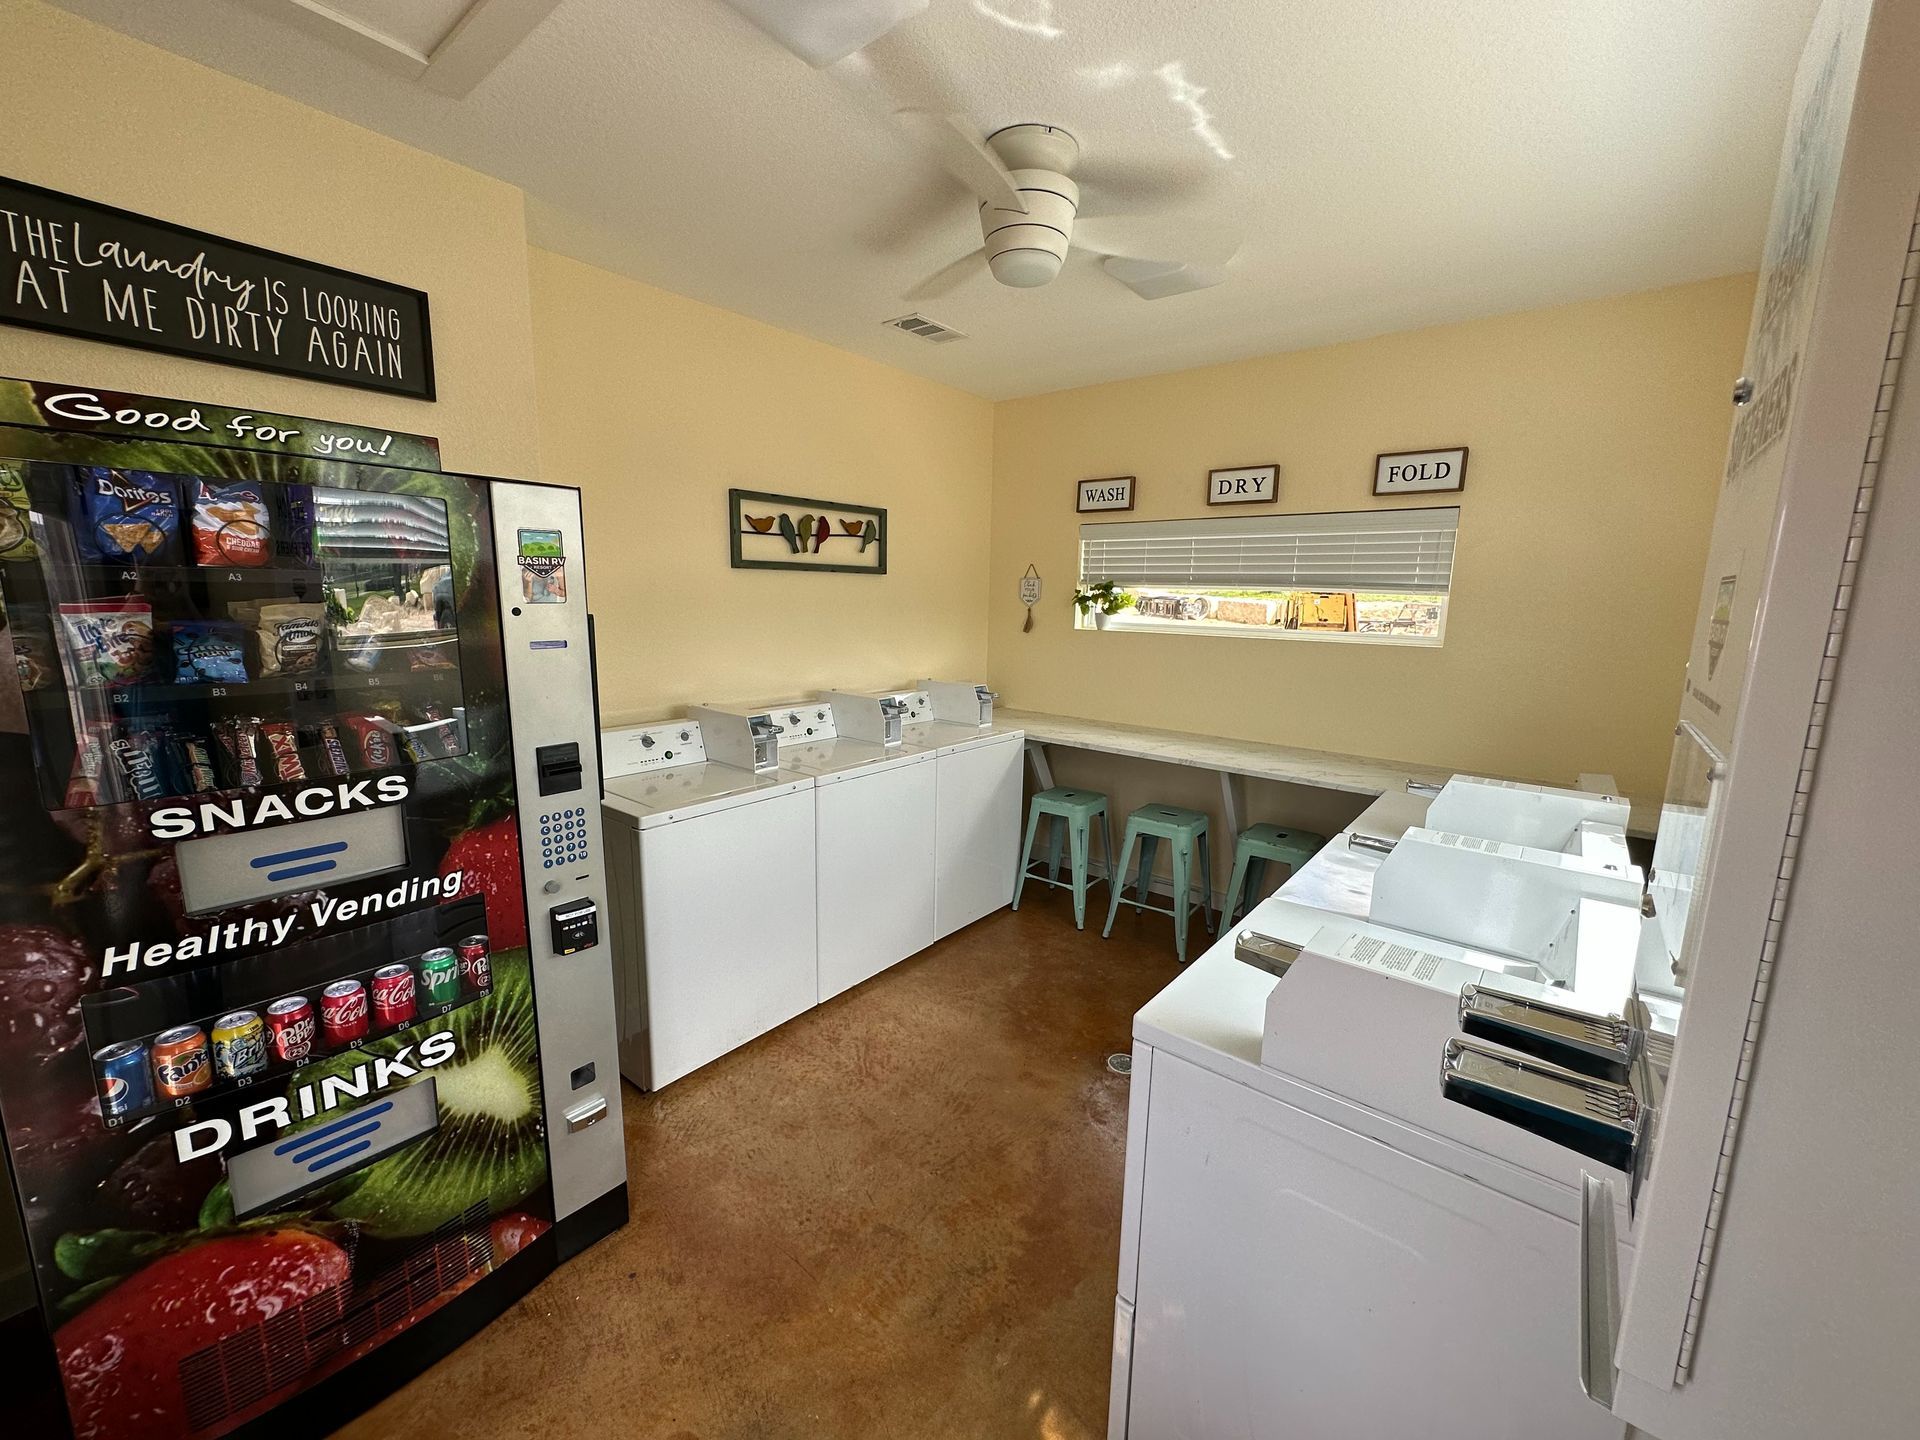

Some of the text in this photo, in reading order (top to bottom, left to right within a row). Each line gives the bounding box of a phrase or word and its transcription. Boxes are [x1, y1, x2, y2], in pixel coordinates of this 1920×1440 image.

[1, 210, 401, 341] THE Laundry IS LOOKING
[16, 260, 402, 379] AT ME DIRTY AGAIN
[44, 393, 393, 457] Good for you!
[1387, 461, 1452, 483] FOLD
[97, 478, 172, 504] Doritos
[1218, 476, 1267, 496] DRY
[1085, 487, 1126, 502] WASH
[226, 537, 261, 549] CHEDDAR
[518, 556, 565, 565] BASIN RV
[121, 571, 138, 580] A2
[228, 573, 242, 582] A3
[322, 575, 335, 583] A4
[274, 619, 319, 636] Famous
[295, 682, 308, 691] B4
[368, 678, 380, 686] B5
[212, 688, 227, 697] B3
[113, 694, 129, 703] B2
[150, 775, 408, 839] SNACKS
[101, 870, 463, 977] Healthy Vending
[480, 989, 490, 997] D8
[441, 1004, 452, 1013] D7
[294, 1018, 310, 1033] Dr
[398, 1022, 410, 1031] D6
[350, 1039, 363, 1049] D5
[296, 1057, 310, 1068] D4
[237, 1077, 253, 1088] D3
[174, 1030, 457, 1164] DRINKS
[175, 1096, 191, 1107] D2
[108, 1116, 124, 1127] D1
